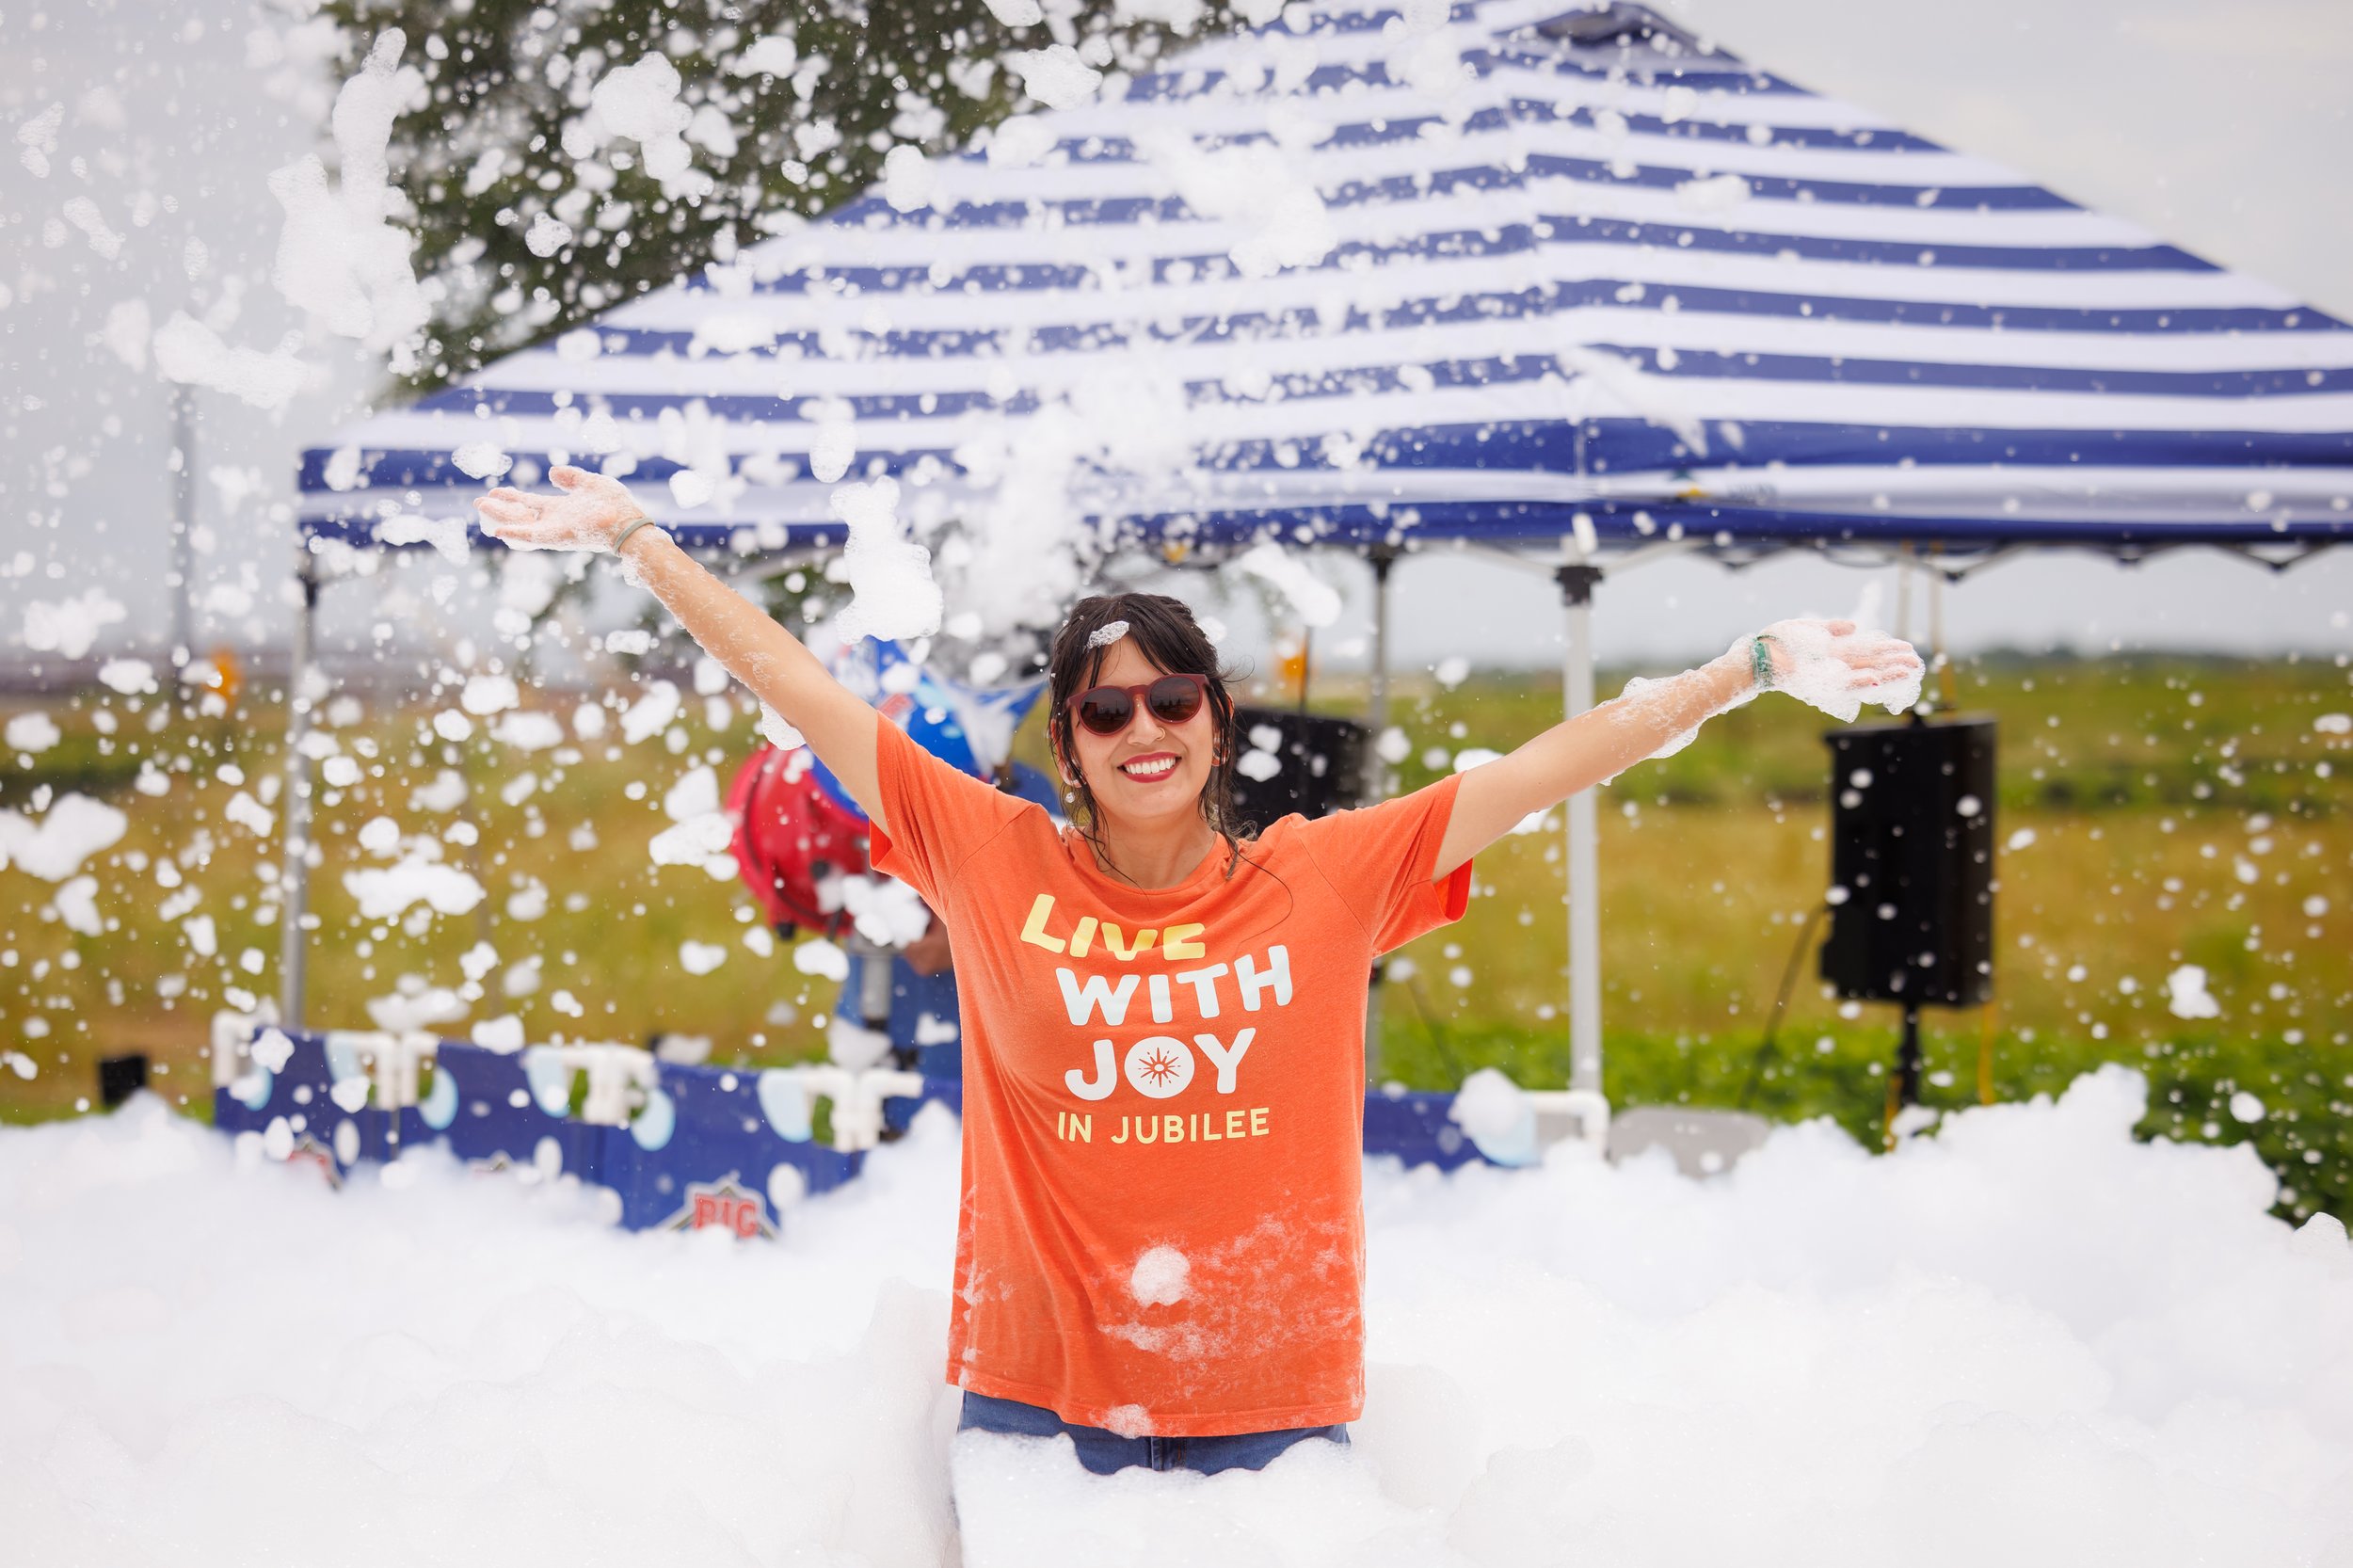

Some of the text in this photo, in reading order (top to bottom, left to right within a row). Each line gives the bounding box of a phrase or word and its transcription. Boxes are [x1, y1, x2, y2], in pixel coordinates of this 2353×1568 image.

[1019, 893, 1207, 962] LIVE
[1055, 944, 1293, 1027] WITH
[1064, 1027, 1257, 1101] JOY
[1057, 1107, 1271, 1145] IN JUBILEE
